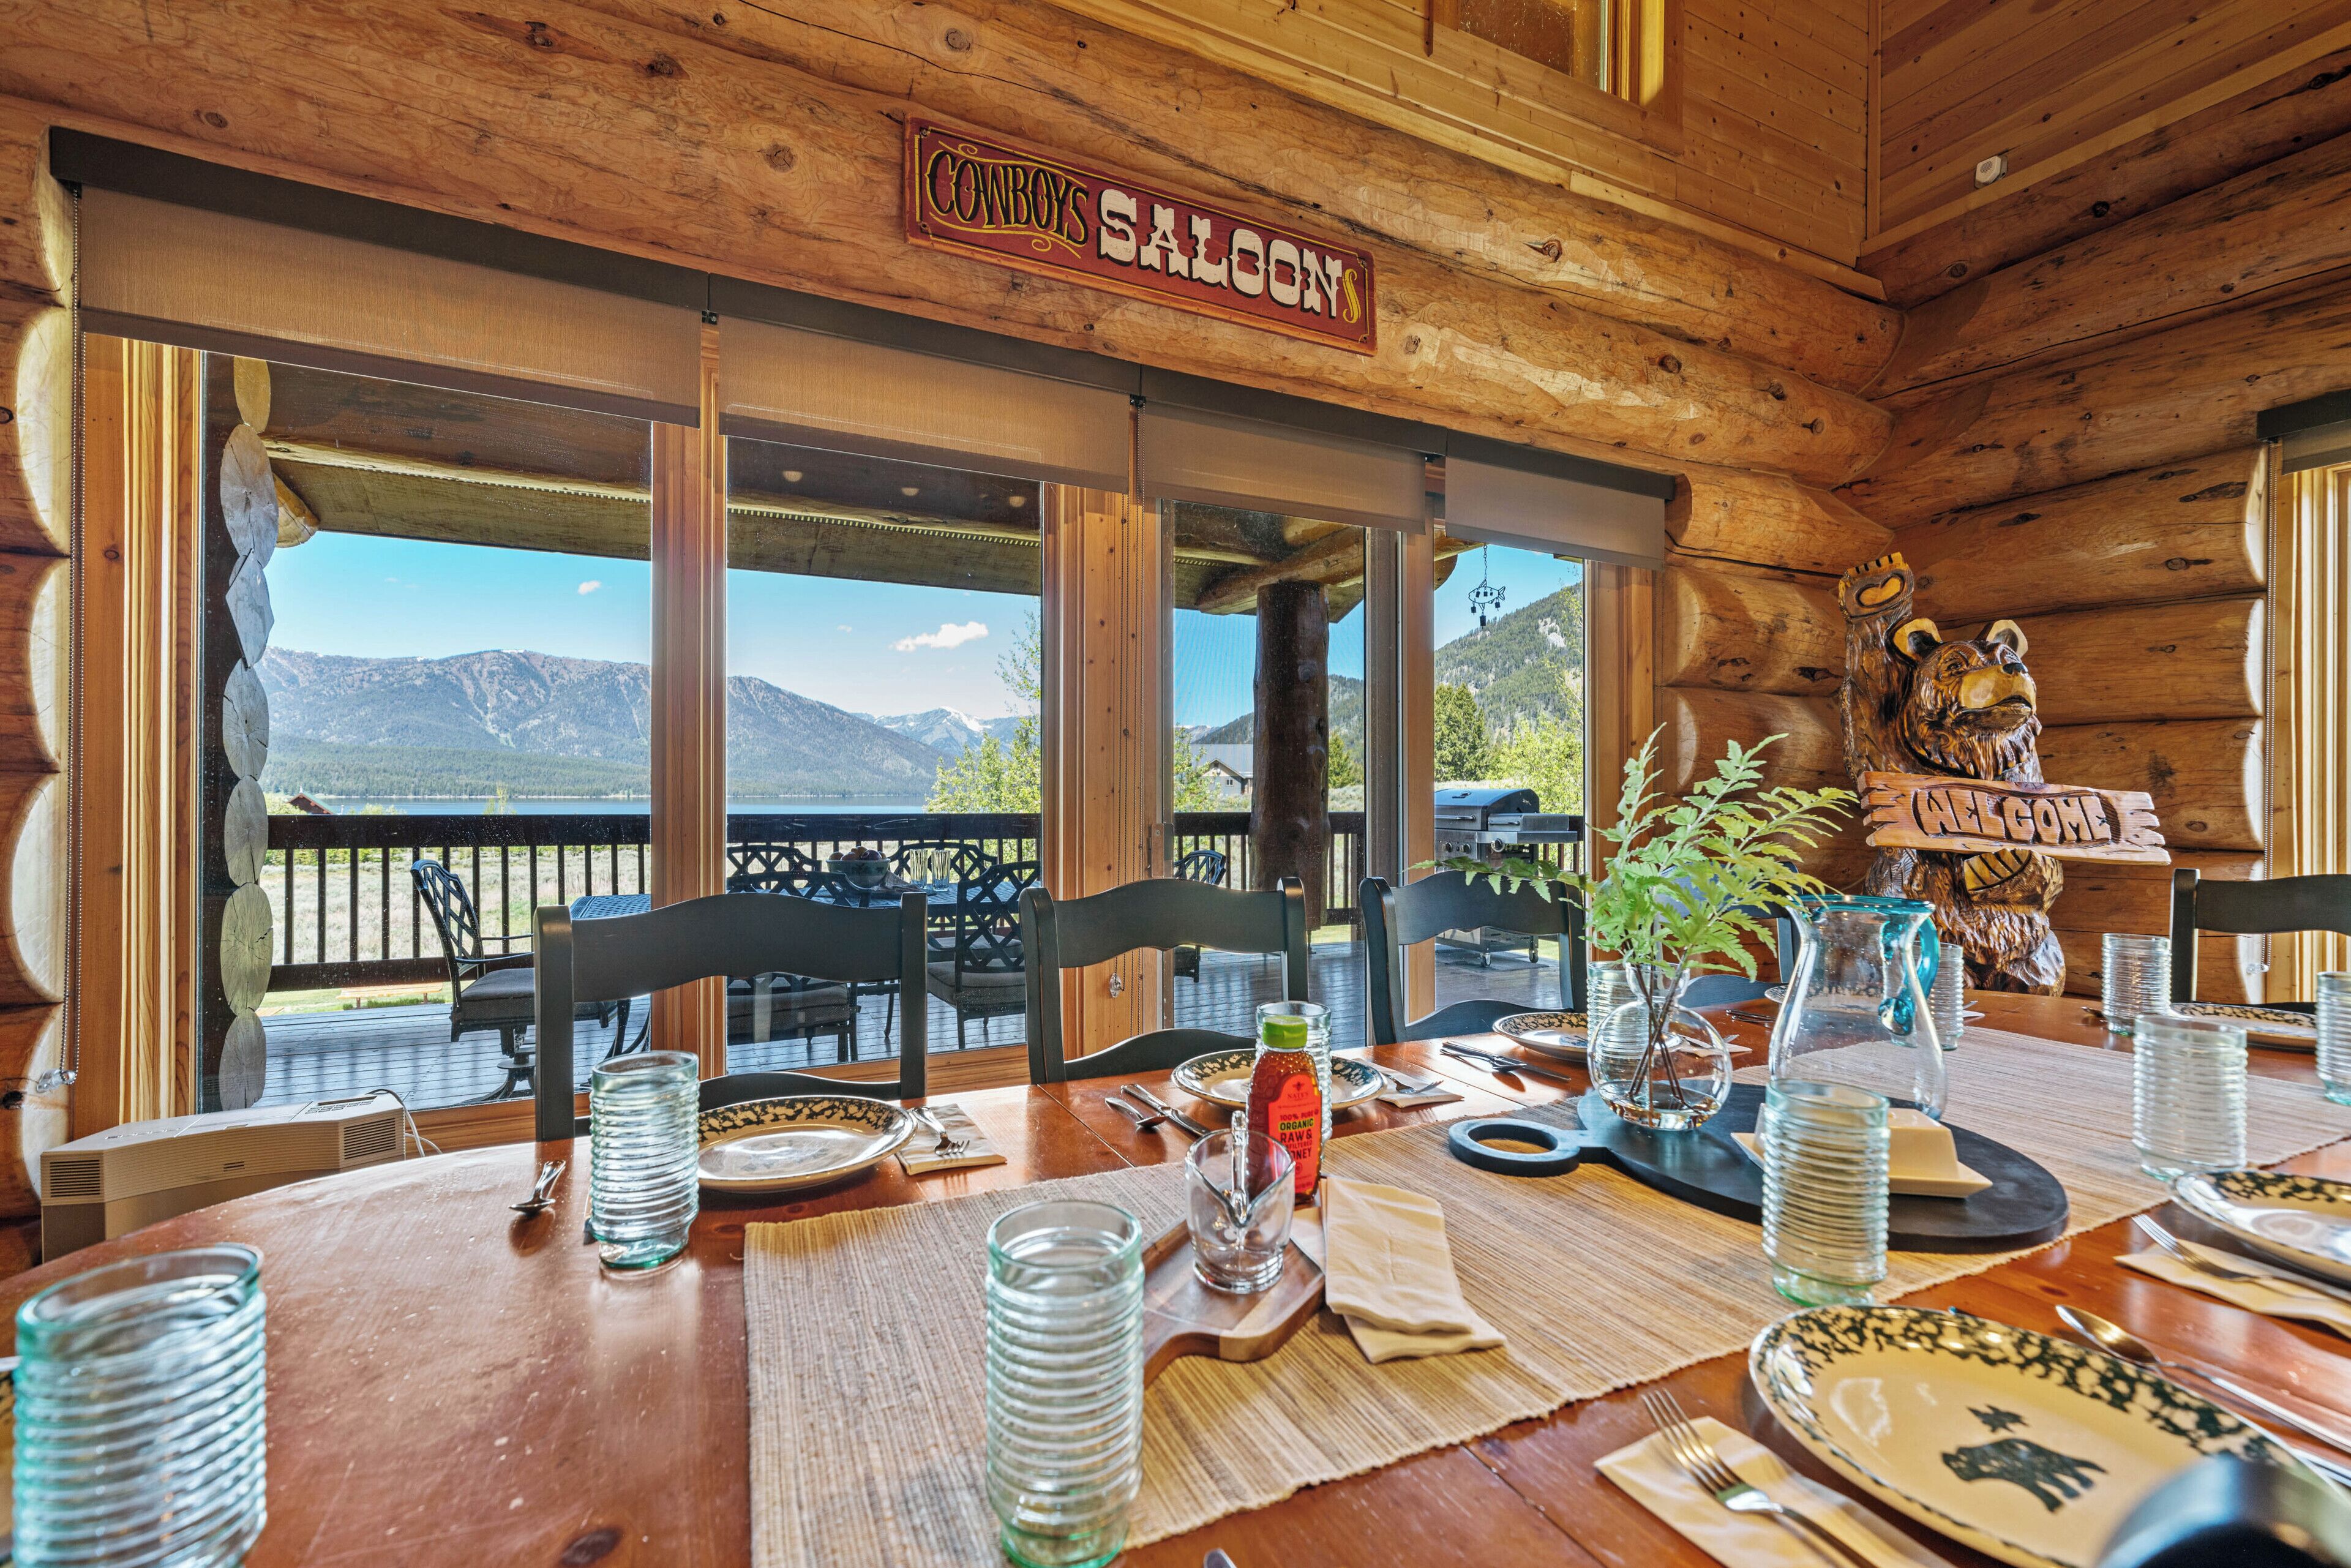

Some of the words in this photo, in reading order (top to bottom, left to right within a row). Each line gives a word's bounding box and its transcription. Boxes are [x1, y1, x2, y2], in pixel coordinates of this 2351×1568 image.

[925, 149, 1089, 246] COWBOYS
[1912, 789, 2112, 846] WELCOME
[1280, 1118, 1313, 1131] ORGANIC
[1280, 1130, 1304, 1142] RAW
[1306, 1129, 1312, 1139] &
[1286, 1140, 1313, 1149] NFILTERED
[1291, 1147, 1311, 1160] ONEY
